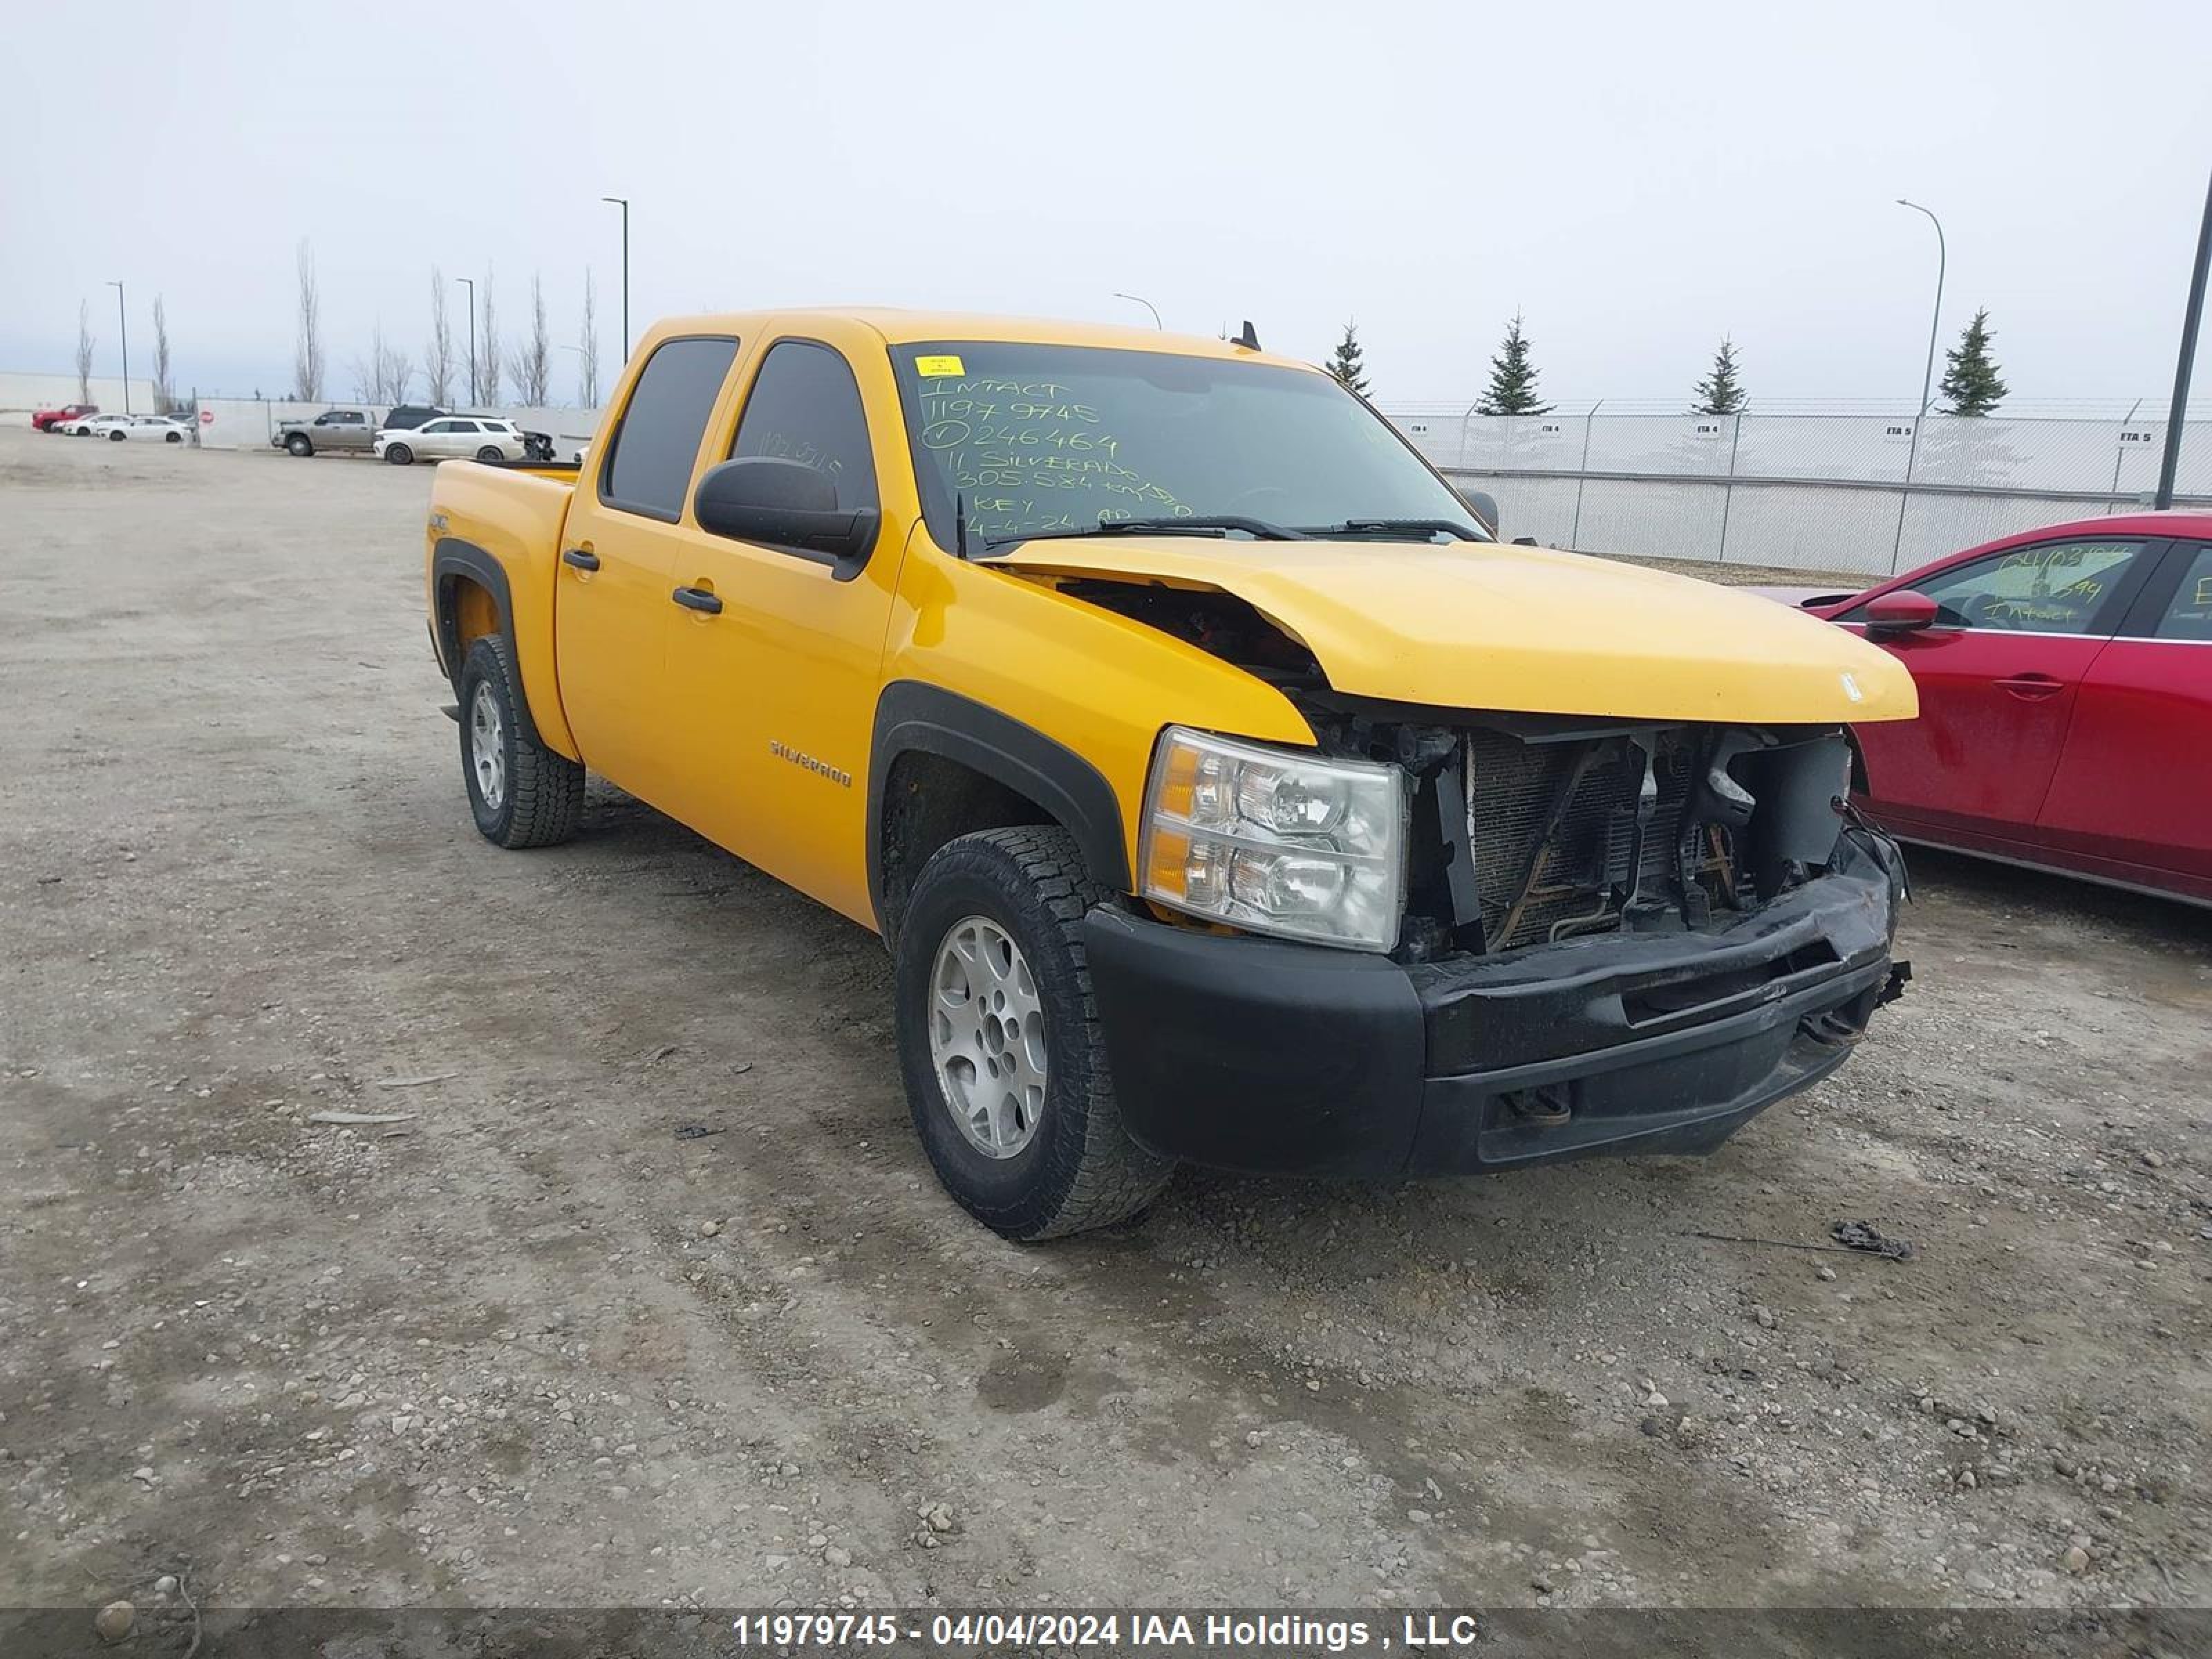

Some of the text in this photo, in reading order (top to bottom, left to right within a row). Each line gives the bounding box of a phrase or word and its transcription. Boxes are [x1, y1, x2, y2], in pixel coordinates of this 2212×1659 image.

[2120, 433, 2151, 442] ETA 5
[769, 740, 852, 788] SILVERADO
